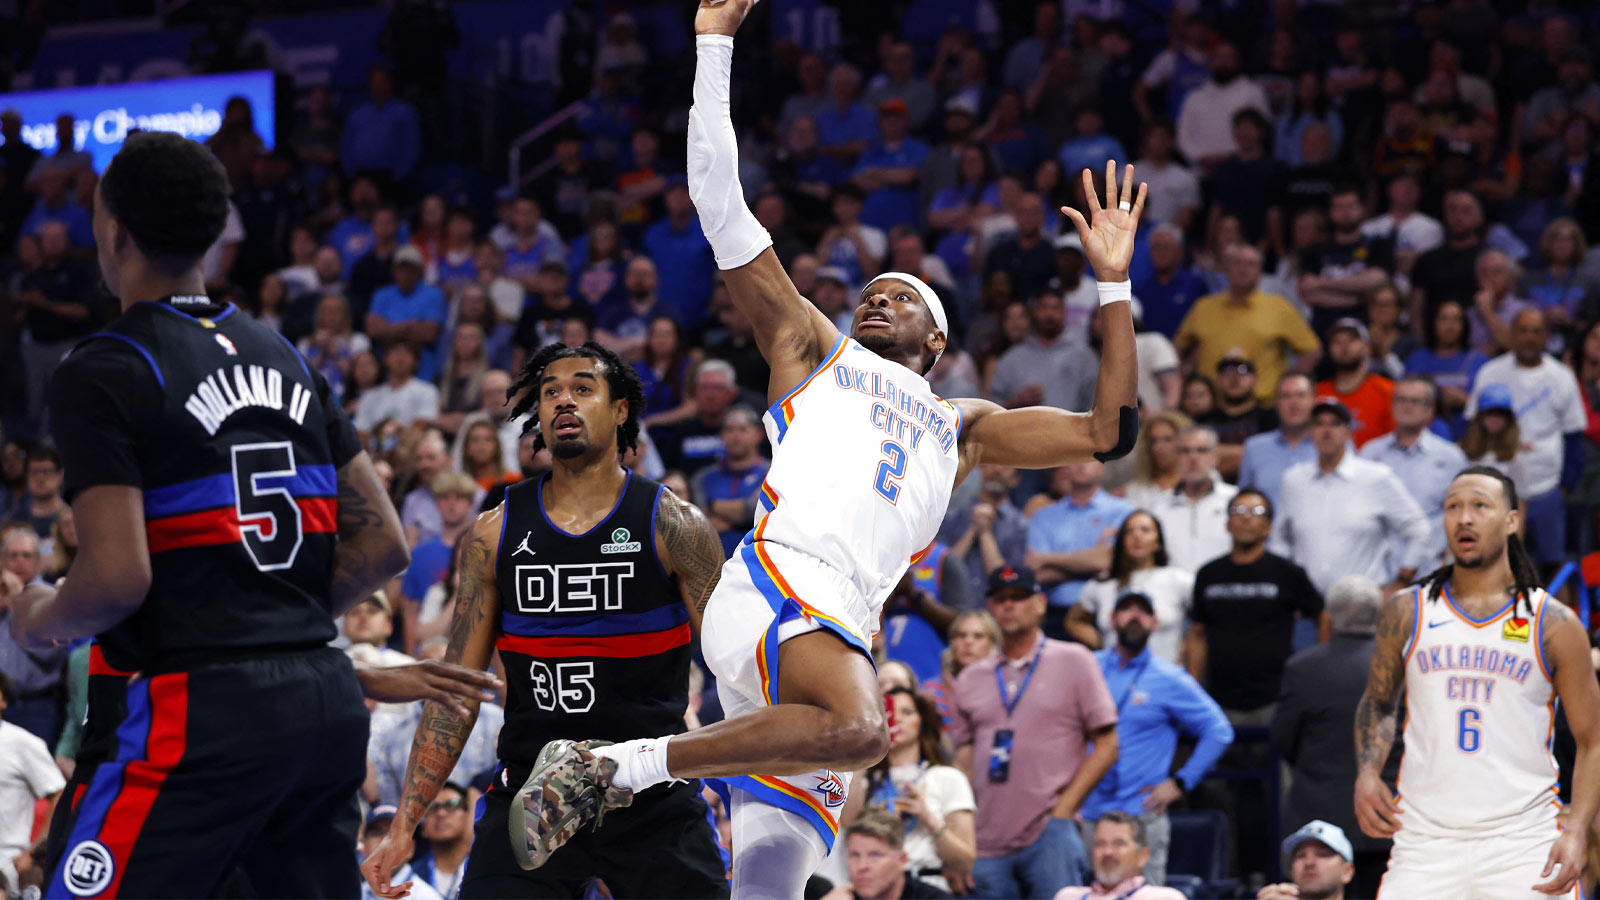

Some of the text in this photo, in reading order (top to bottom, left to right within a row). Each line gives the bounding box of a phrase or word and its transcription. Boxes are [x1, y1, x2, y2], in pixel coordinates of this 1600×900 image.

[184, 364, 311, 436] HOLLAND II
[833, 363, 956, 455] OKLAHOMA
[870, 402, 925, 453] CITY
[873, 439, 908, 506] 2
[231, 441, 303, 572] 5
[602, 543, 639, 553] StockX
[515, 562, 634, 612] DET
[530, 661, 595, 713] 35
[1415, 644, 1534, 686] OKLAHOMA
[1446, 675, 1496, 704] CITY
[1456, 705, 1482, 756] 6
[71, 854, 105, 882] DET
